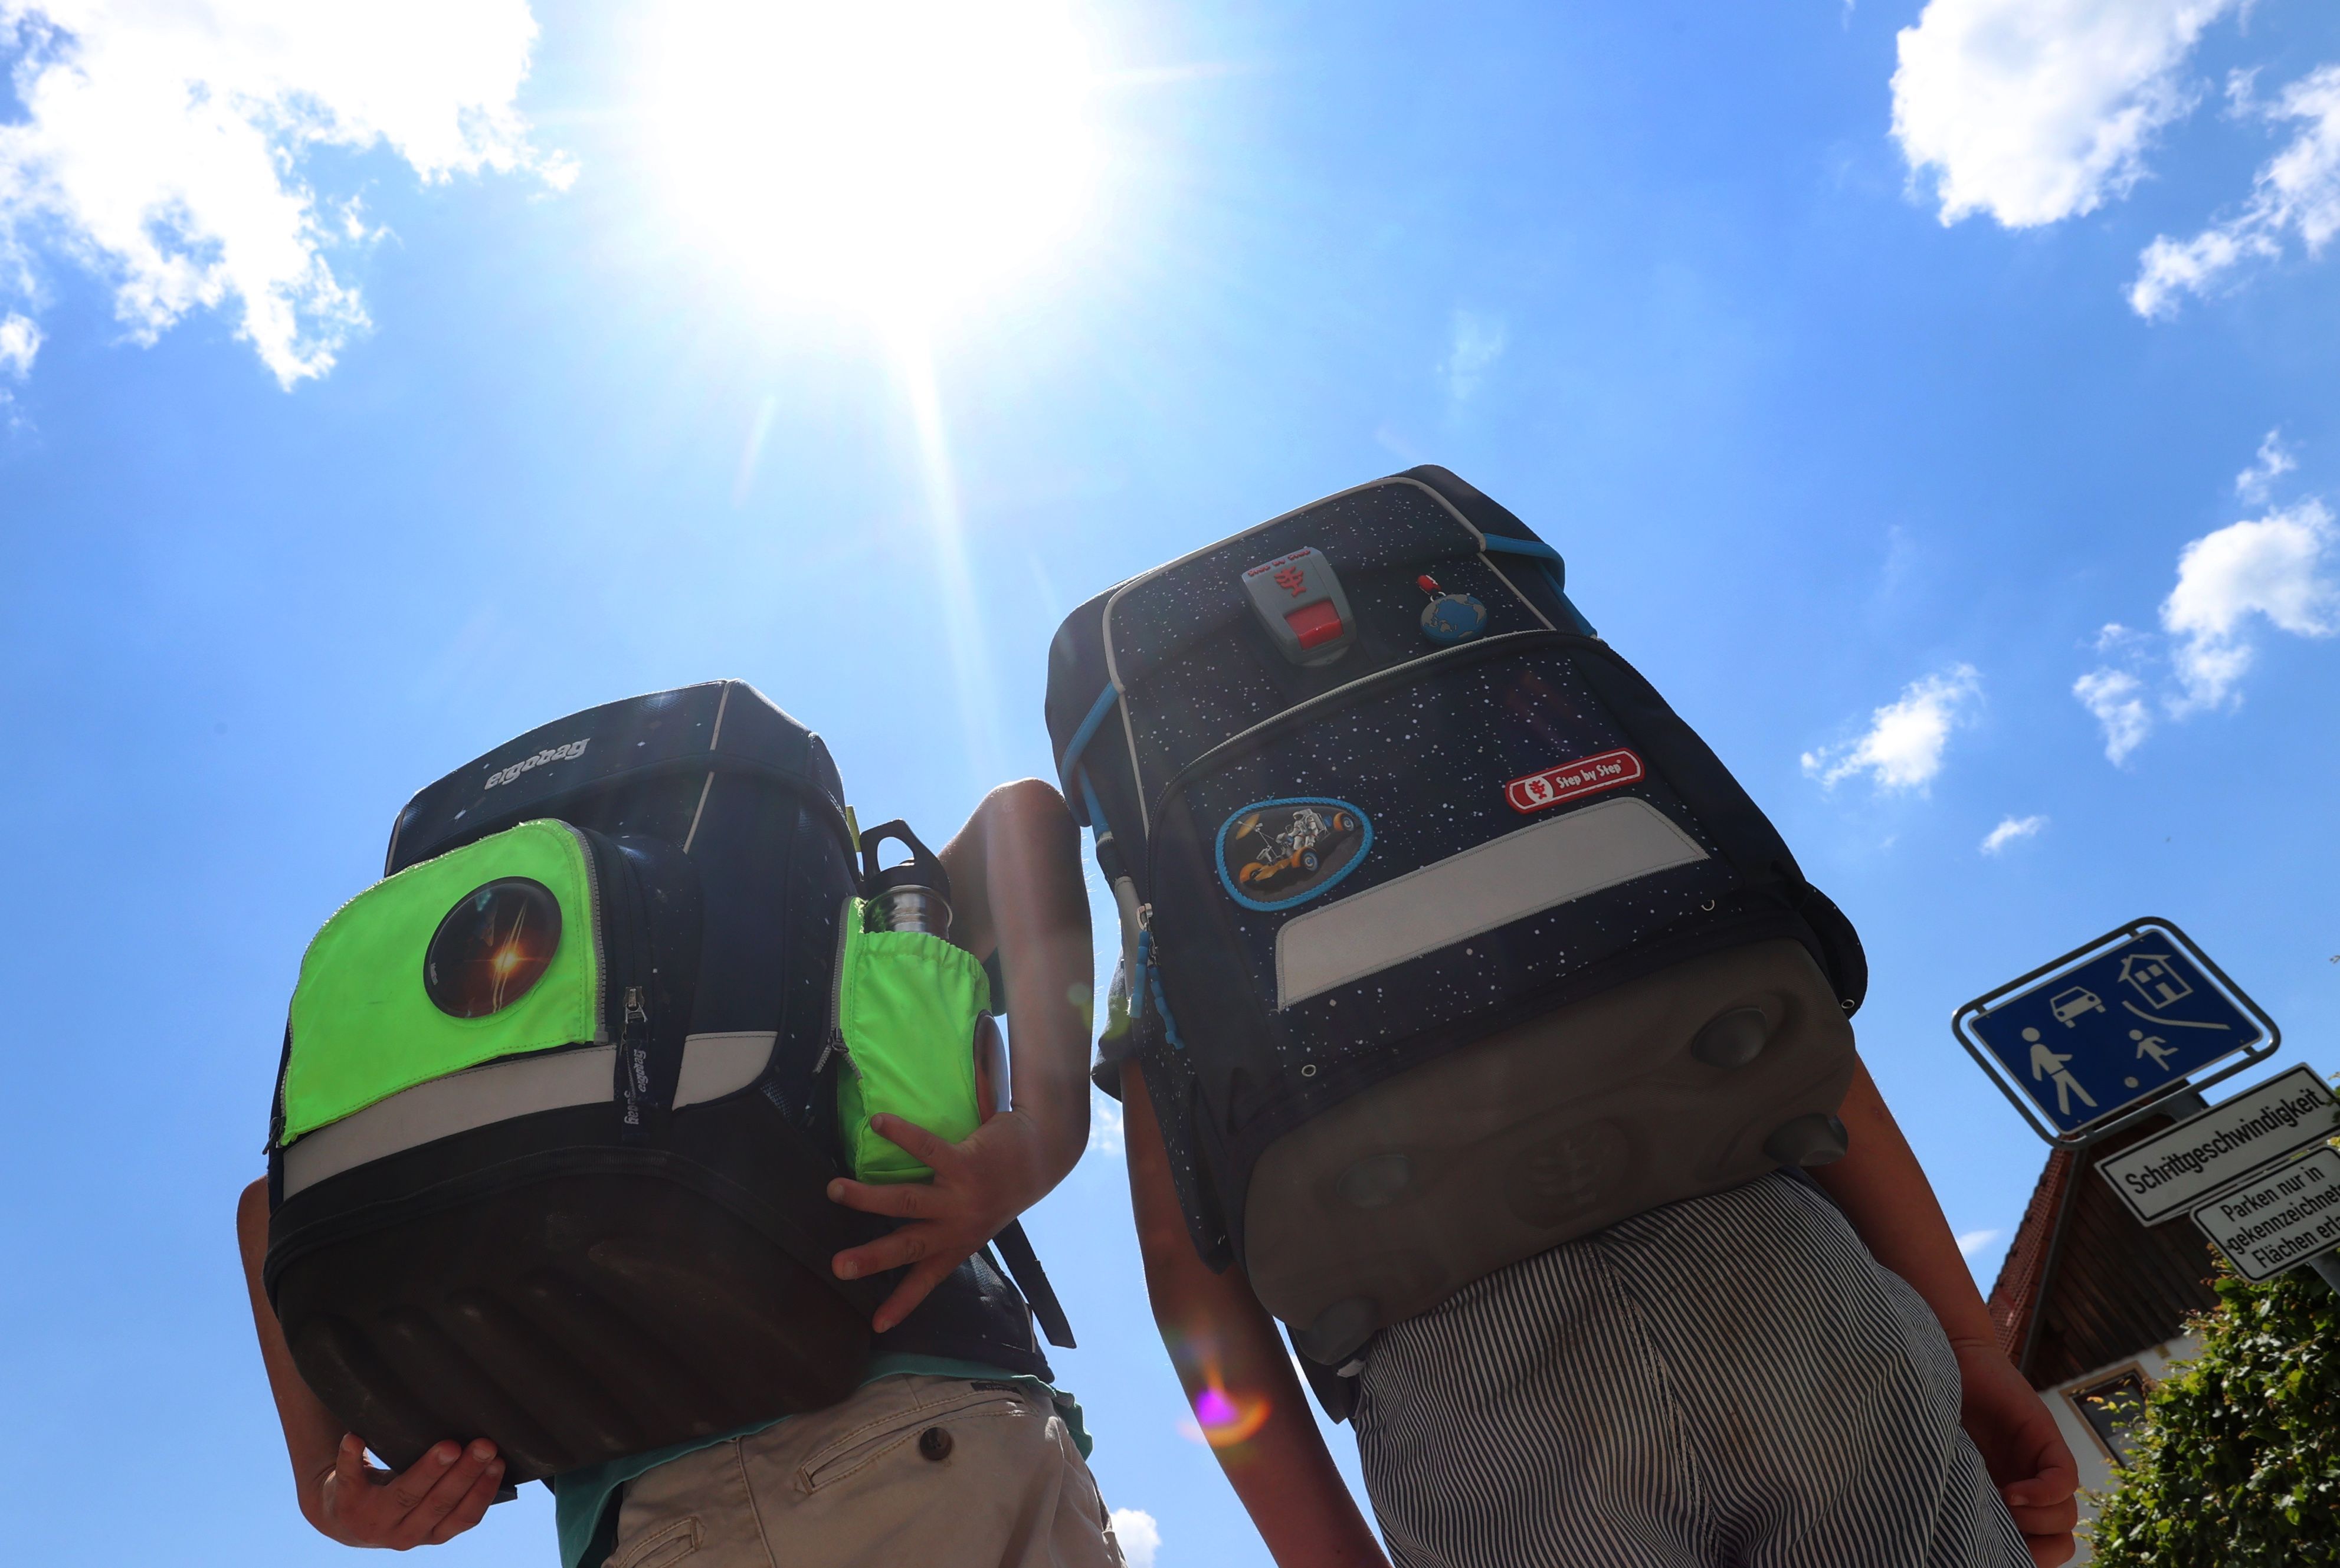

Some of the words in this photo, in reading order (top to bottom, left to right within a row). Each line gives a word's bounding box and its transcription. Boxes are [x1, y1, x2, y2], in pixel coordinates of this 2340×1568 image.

[484, 737, 591, 790] ergobag
[1555, 776, 1581, 789] Step
[1580, 769, 1597, 781] by
[634, 1049, 648, 1092] ergobag
[2125, 1088, 2325, 1195] Schrittgeschwindigkeit
[2220, 1188, 2280, 1222] Parken
[2276, 1175, 2306, 1196] nur
[2300, 1166, 2326, 1182] in
[2227, 1185, 2340, 1255] gekennzeichnet
[2251, 1231, 2319, 1269] Flächen
